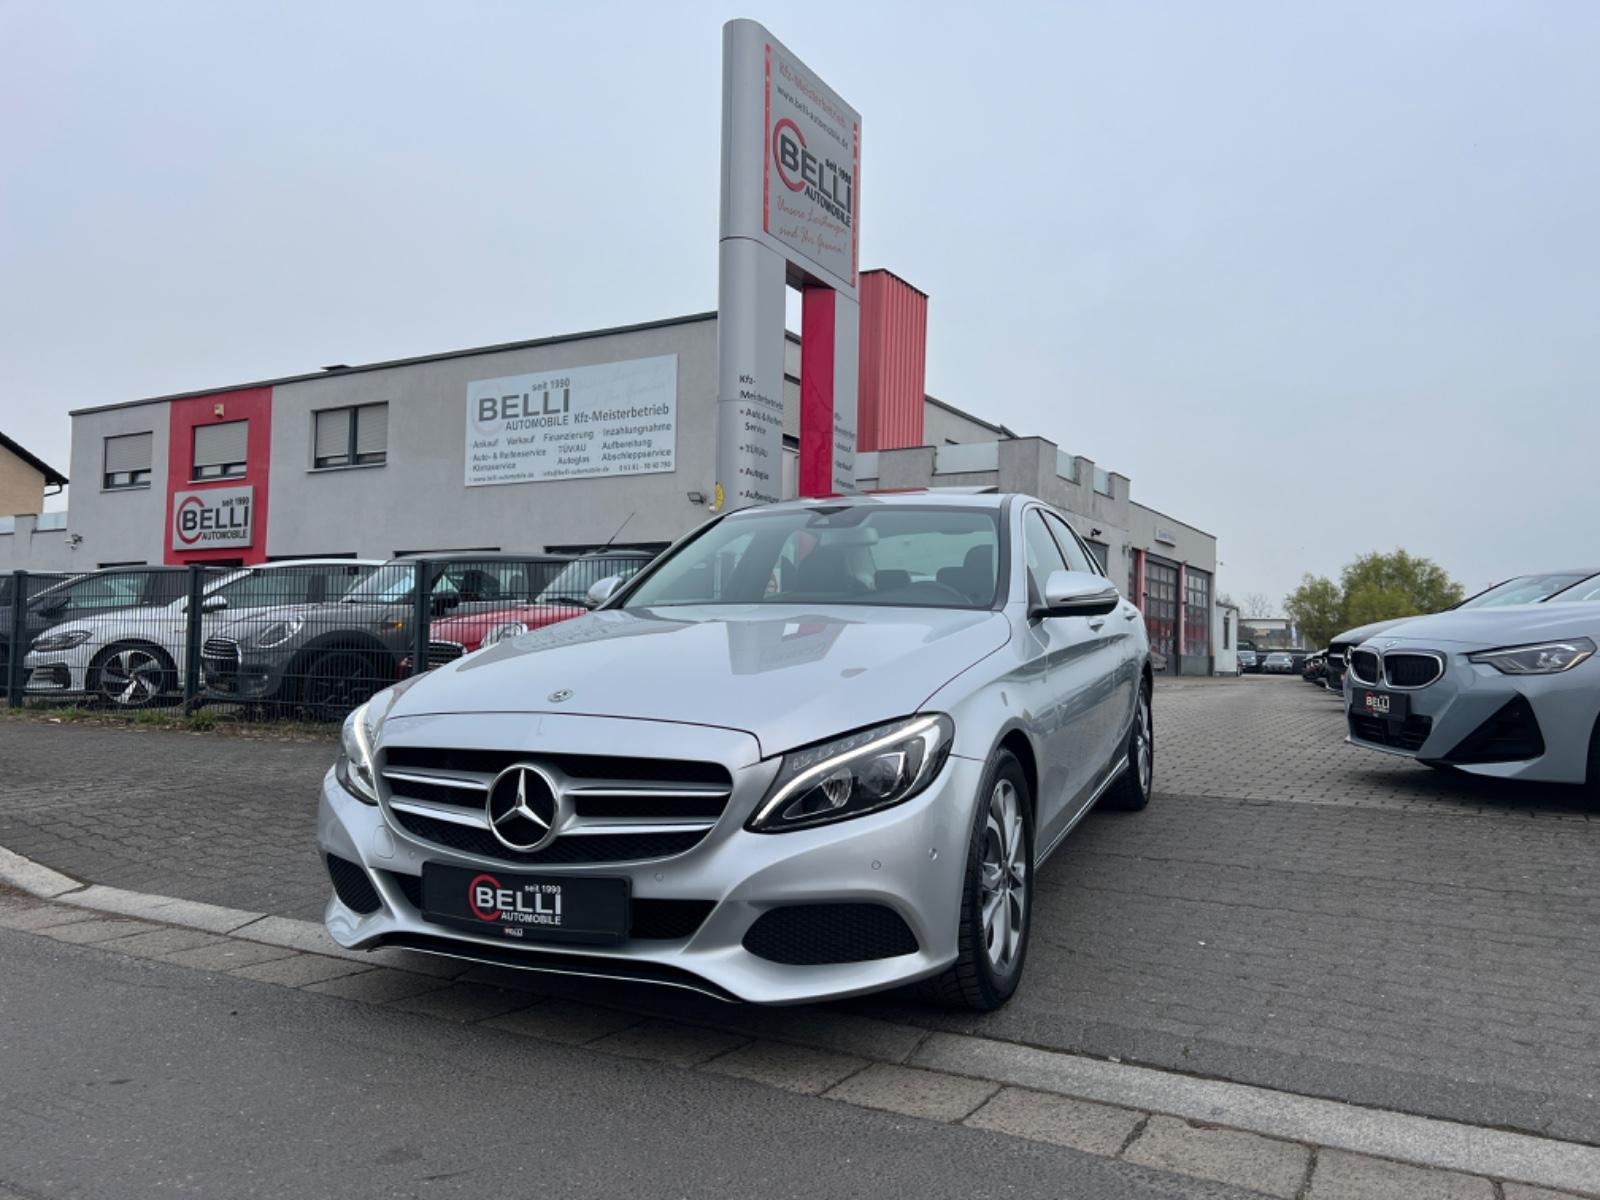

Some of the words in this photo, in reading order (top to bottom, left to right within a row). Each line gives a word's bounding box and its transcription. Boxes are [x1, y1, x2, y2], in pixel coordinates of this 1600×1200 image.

[780, 133, 851, 214] BELLI
[804, 185, 851, 228] AUTOMOBILE
[532, 382, 548, 392] seit
[550, 378, 570, 389] 1990
[478, 388, 570, 422] BELLI
[573, 403, 670, 424] Kfz-Meisterbetrieb
[505, 415, 569, 431] AUTOMOBILE
[473, 438, 499, 449] Ankauf
[506, 435, 536, 446] Verkauf
[544, 430, 594, 442] Finanzierung
[602, 422, 672, 437] Inzahlungnahme
[601, 439, 652, 450] Aufbereitung
[601, 448, 672, 461] Abschleppservice
[473, 463, 516, 473] Klimaservice
[222, 498, 234, 507] seit
[235, 496, 249, 506] 1990
[182, 506, 249, 531] BELLI
[202, 529, 248, 541] AUTOMOBILE
[1366, 696, 1389, 708] BELLI
[524, 885, 540, 893] seit
[541, 885, 561, 895] 1990
[476, 887, 561, 914] BELLI
[501, 911, 561, 925] AUTOMOBILE
